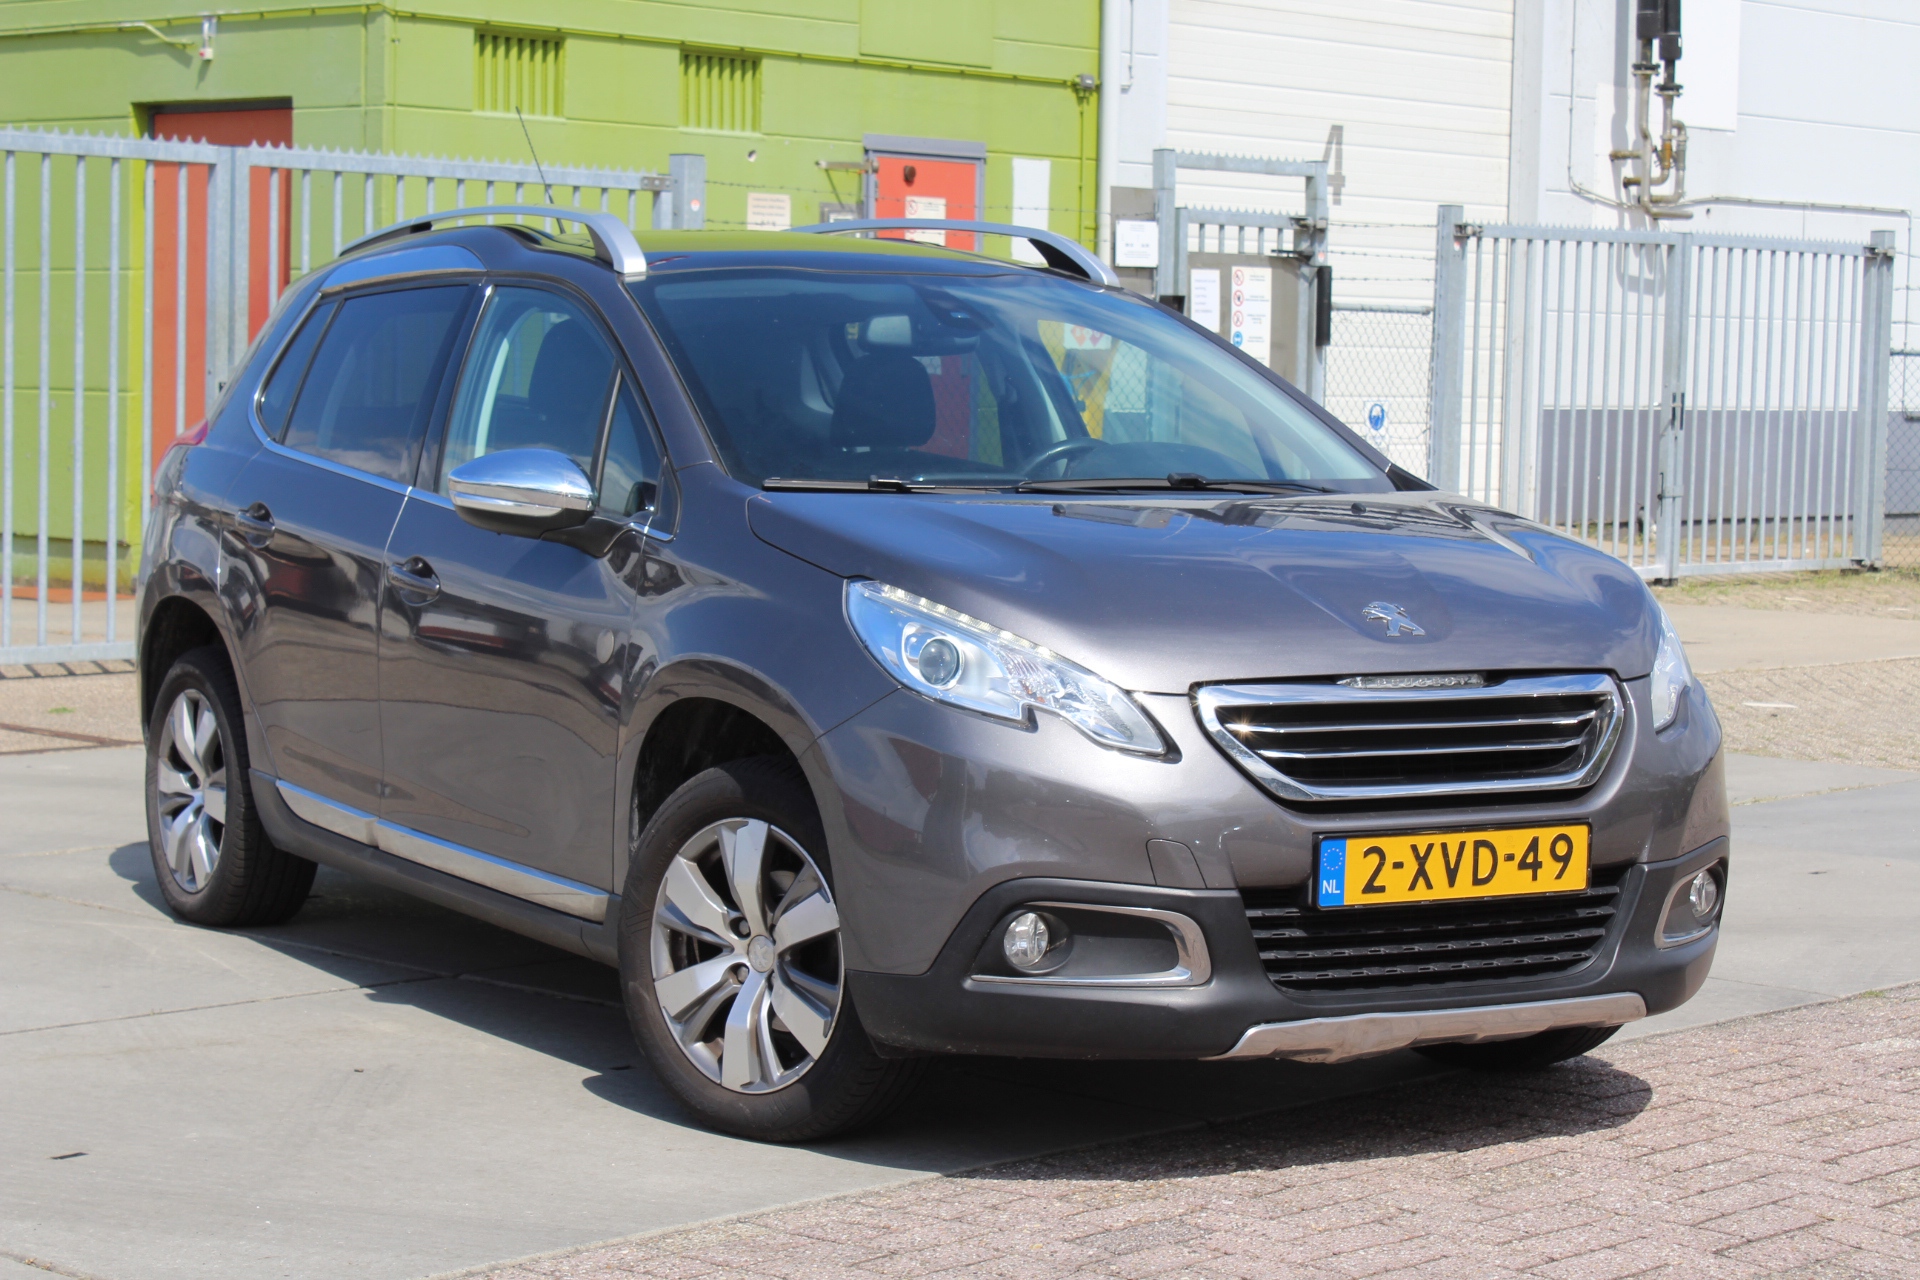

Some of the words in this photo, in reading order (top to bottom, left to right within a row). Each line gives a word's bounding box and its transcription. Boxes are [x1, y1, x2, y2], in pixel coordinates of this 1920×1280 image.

[1322, 125, 1345, 206] 4
[1322, 879, 1341, 895] NL
[1361, 833, 1574, 894] 2-XVD-49
